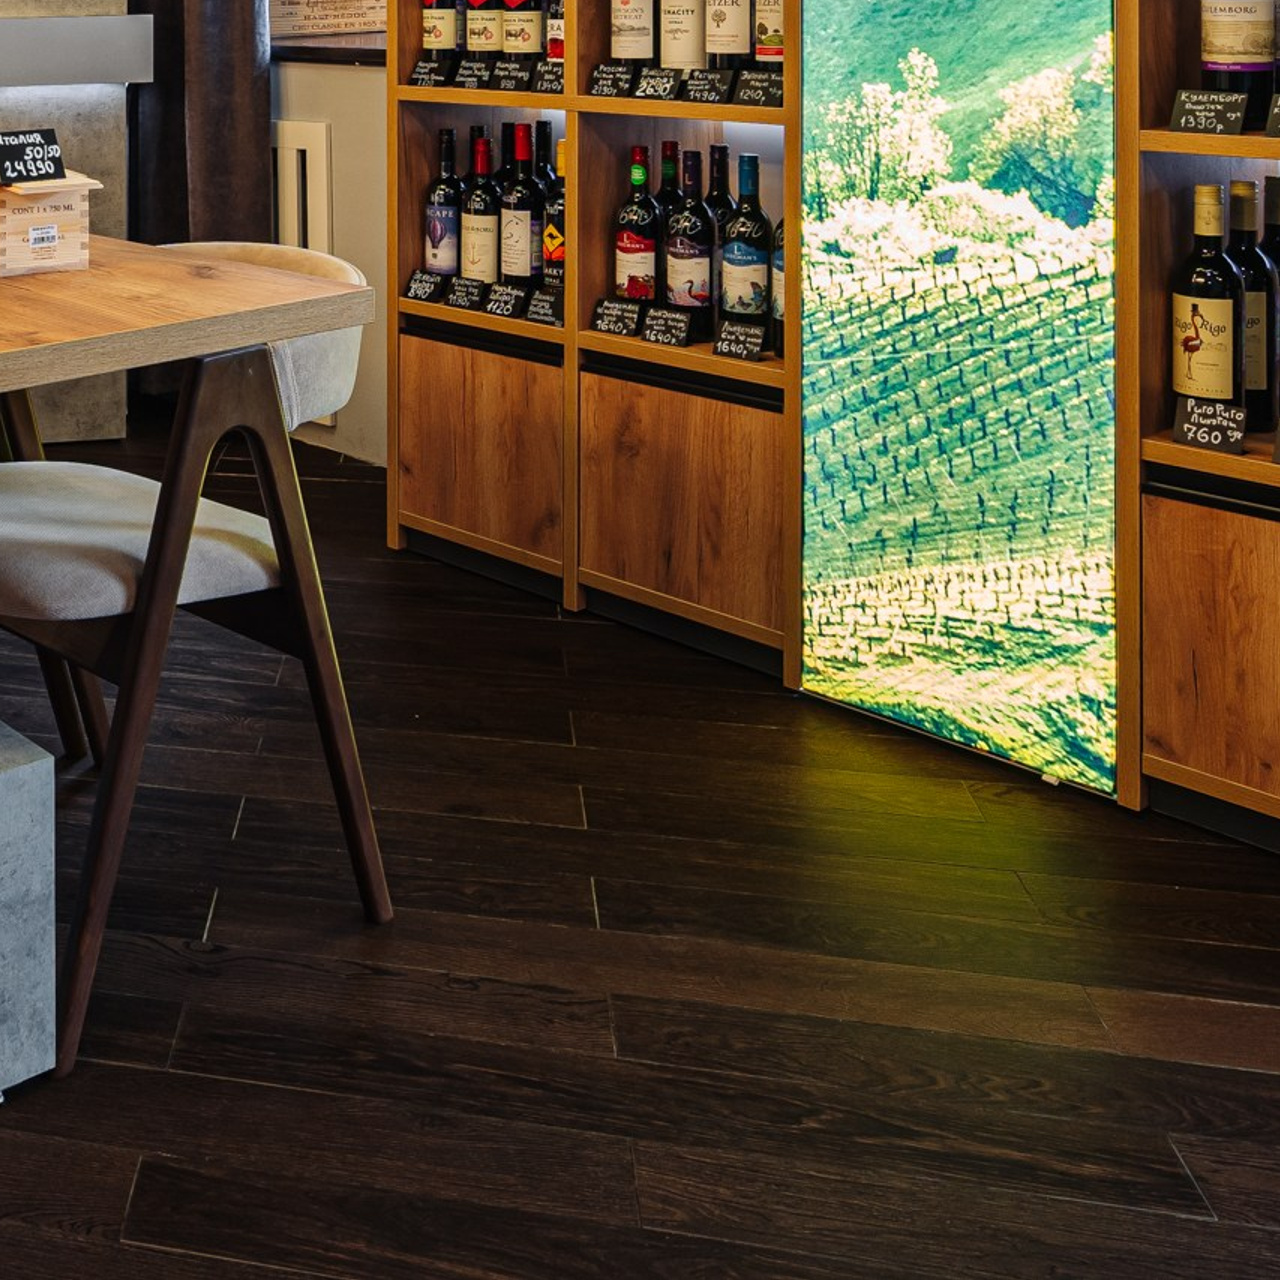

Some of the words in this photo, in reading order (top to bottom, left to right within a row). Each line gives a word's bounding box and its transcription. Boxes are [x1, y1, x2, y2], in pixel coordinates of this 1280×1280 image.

[1202, 5, 1258, 15] LEMBORG
[4, 160, 55, 178] 24990
[11, 205, 35, 215] CONT
[1199, 319, 1227, 338] Rigo
[1184, 423, 1222, 445] 760
